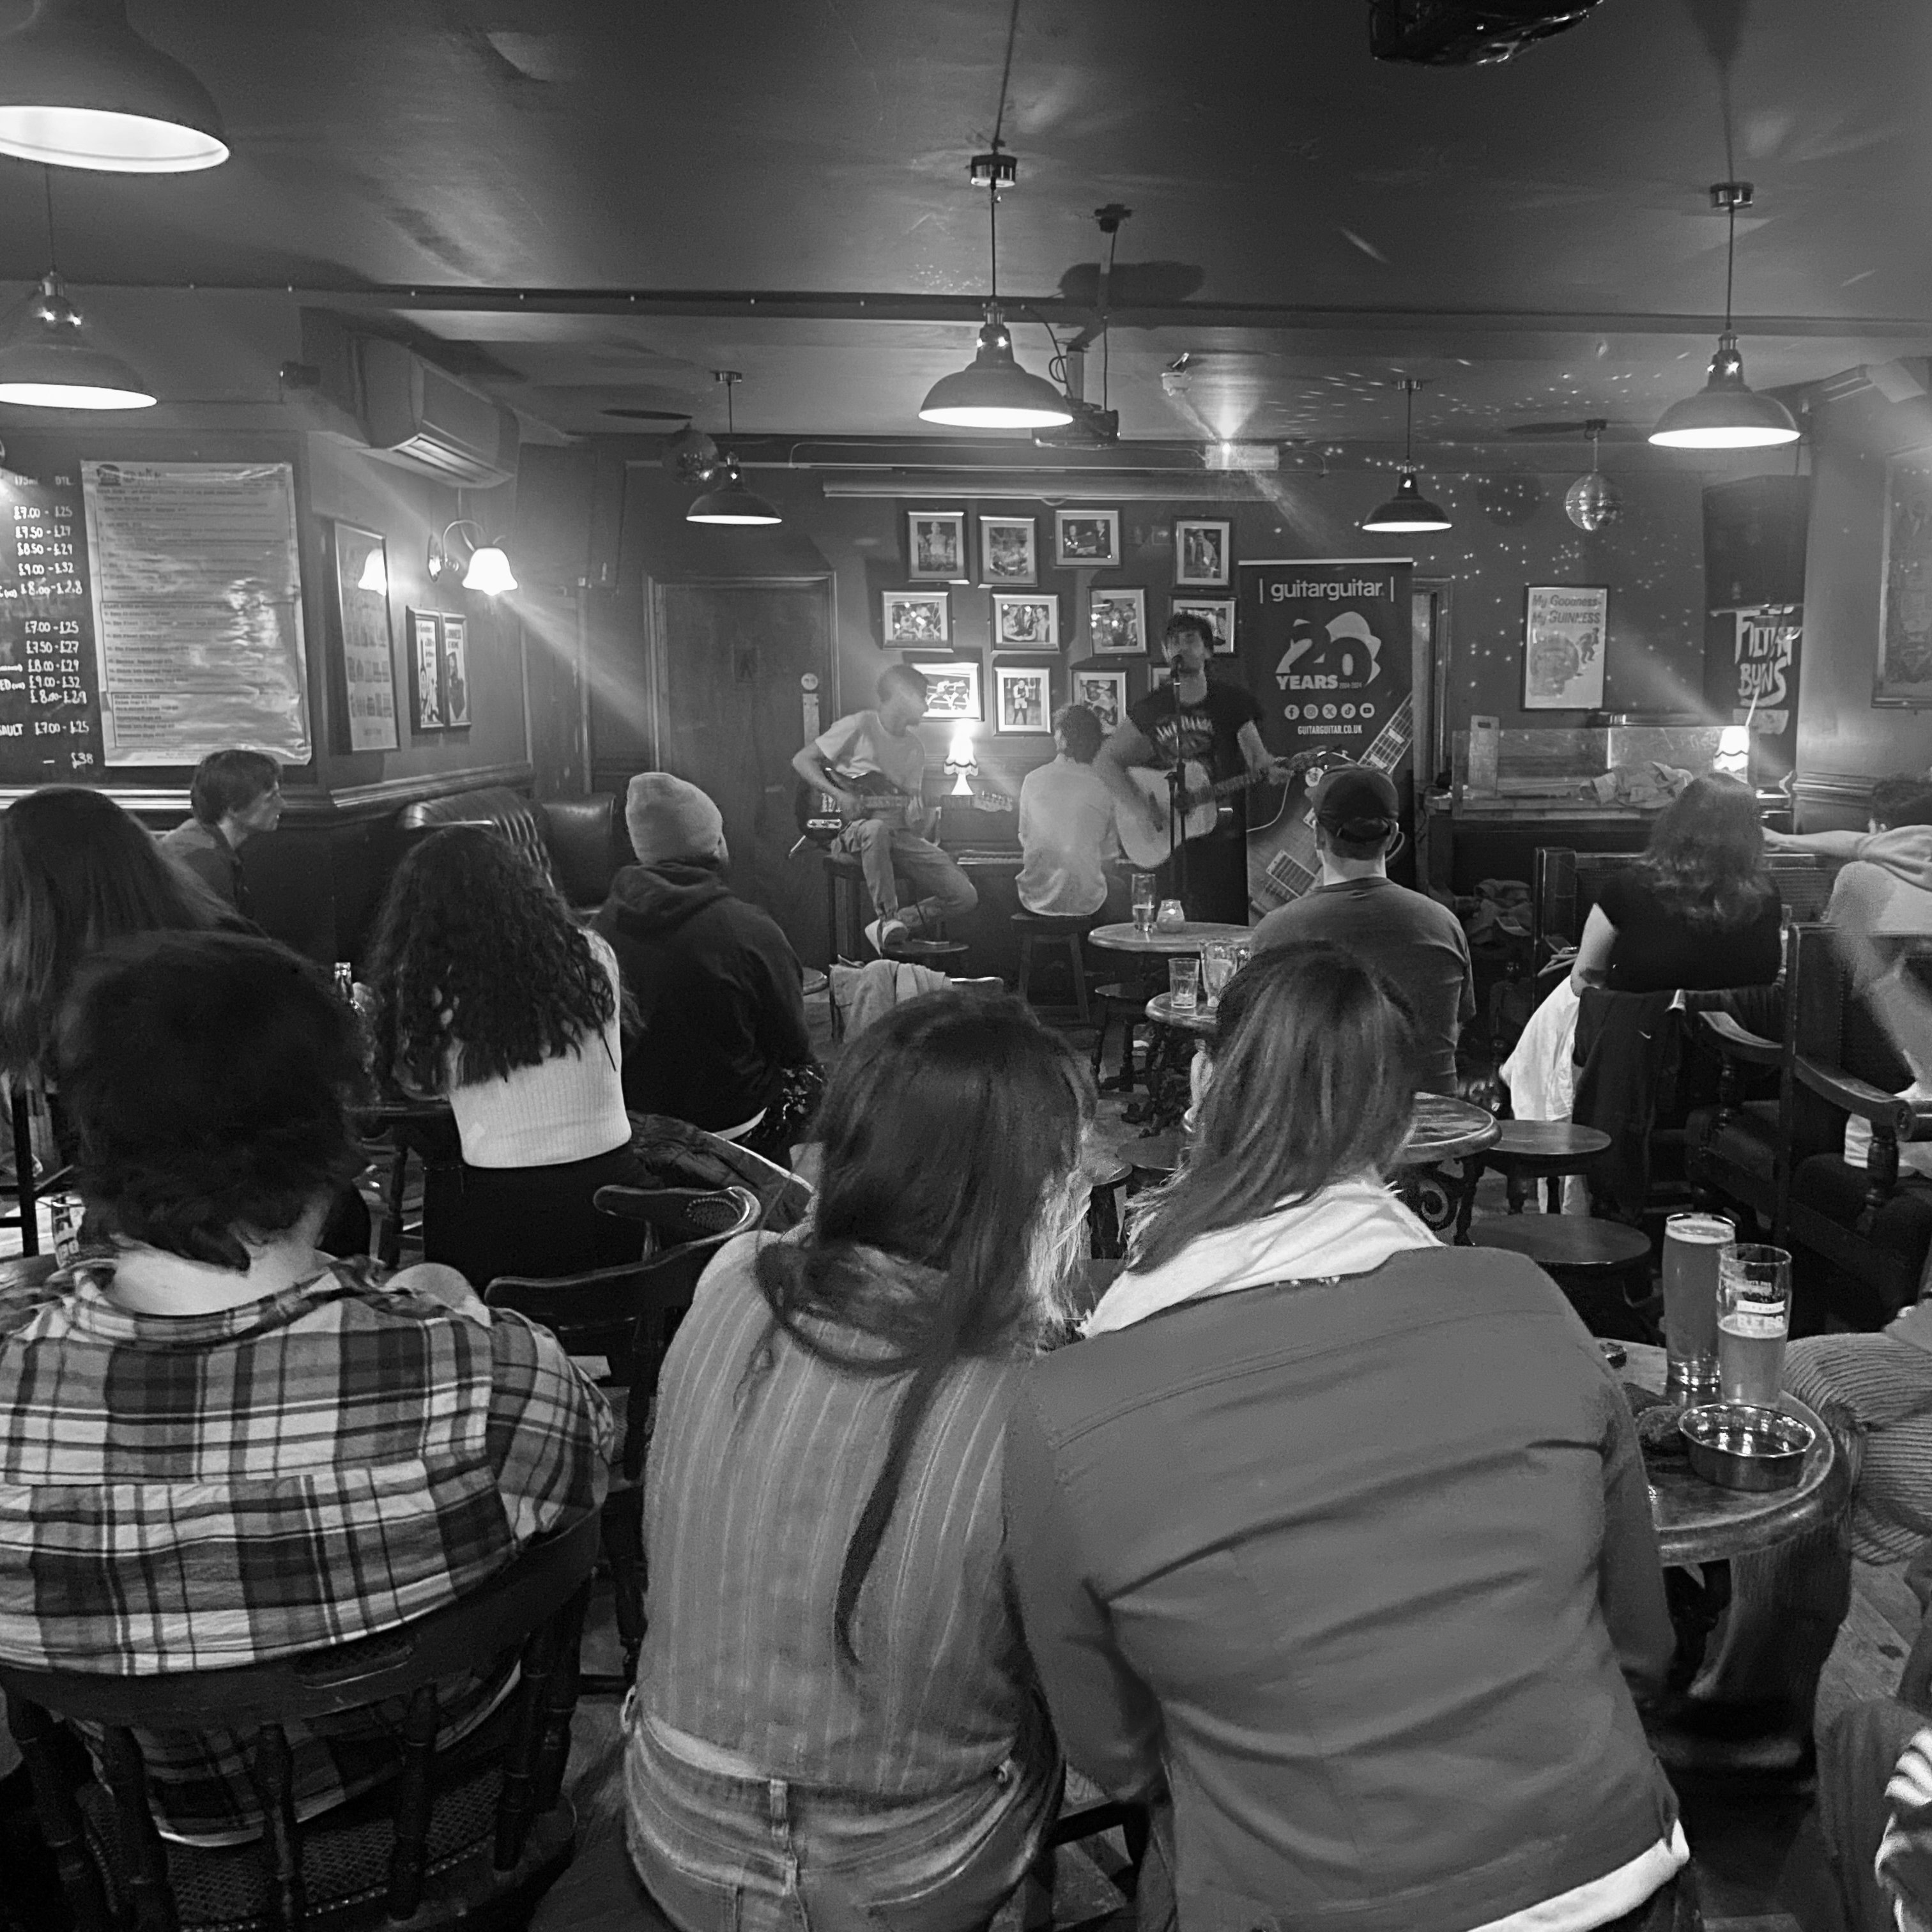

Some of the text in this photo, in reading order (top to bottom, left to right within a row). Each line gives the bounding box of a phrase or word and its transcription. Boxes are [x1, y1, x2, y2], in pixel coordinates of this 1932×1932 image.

[13, 505, 41, 520] £7.00
[54, 562, 74, 574] £32
[1271, 578, 1383, 602] guitarguitar
[59, 620, 79, 634] £25
[59, 640, 79, 654] £27
[62, 676, 81, 689] £32
[1276, 675, 1338, 690] YEARS
[0, 723, 24, 737] AULT
[1298, 724, 1363, 735] GUITARGUITAR.CO.UK
[71, 752, 94, 769] £38
